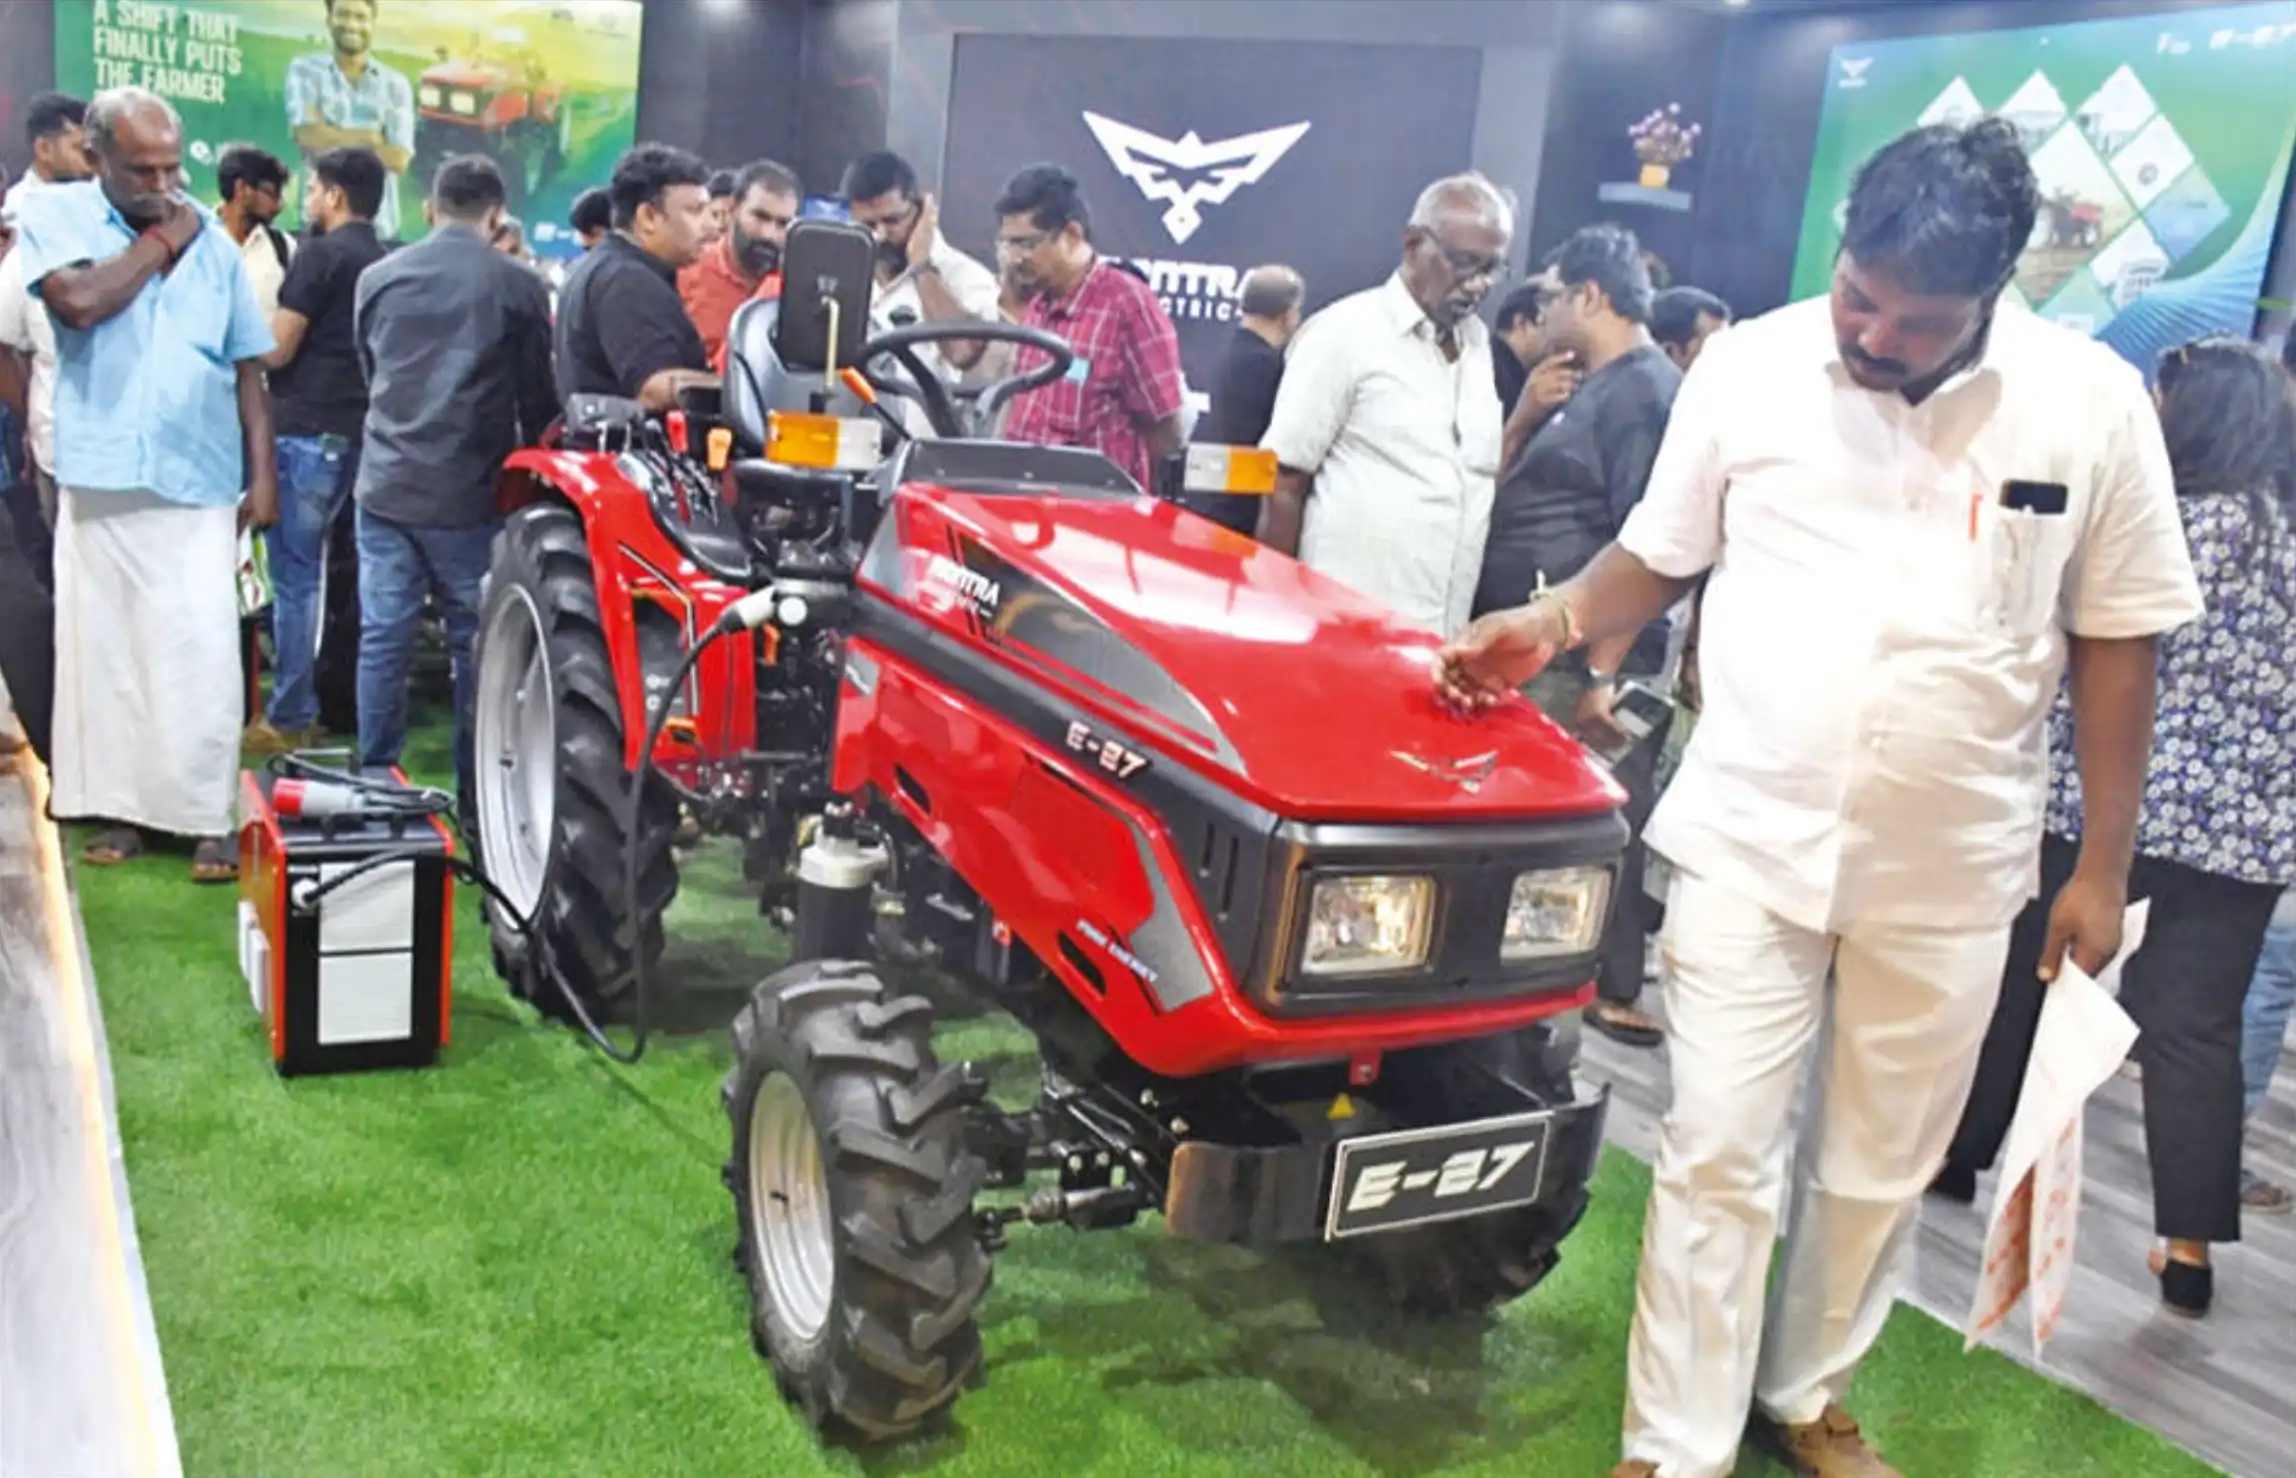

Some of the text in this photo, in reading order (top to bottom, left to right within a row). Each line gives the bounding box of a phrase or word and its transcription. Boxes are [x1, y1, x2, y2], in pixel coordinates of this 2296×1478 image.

[94, 0, 238, 42] A SHIFT THAT
[93, 26, 243, 76] FINALLY PUTS
[94, 57, 226, 104] THE FARMER
[1158, 296, 1232, 322] CTRIC
[1066, 720, 1147, 778] E-27
[1346, 1141, 1535, 1211] E-27
